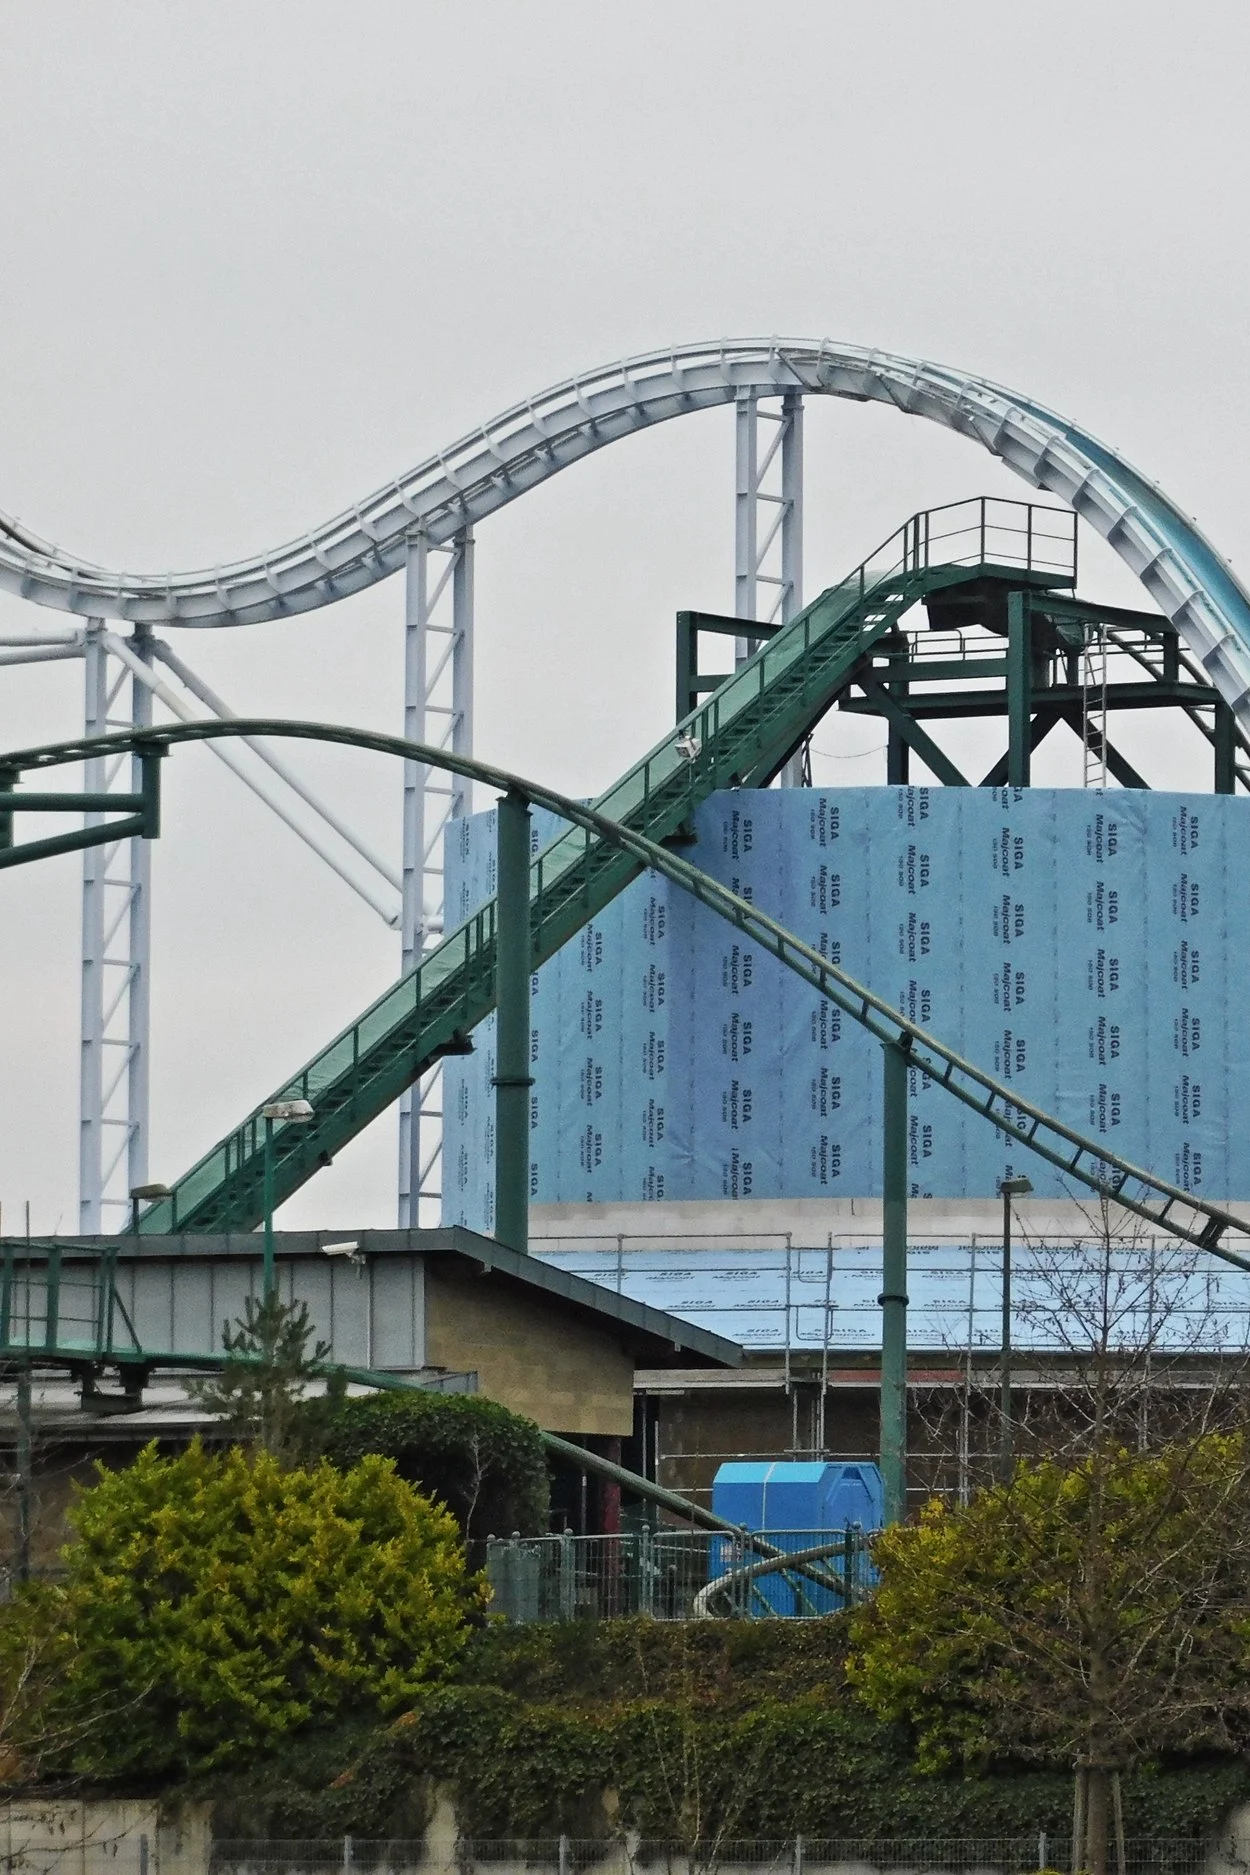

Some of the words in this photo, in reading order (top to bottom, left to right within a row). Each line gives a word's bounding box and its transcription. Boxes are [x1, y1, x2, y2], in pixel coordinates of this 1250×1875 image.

[920, 788, 929, 820] SIGA
[730, 811, 739, 860] Majcoat
[743, 820, 752, 852] SIGA
[817, 798, 826, 847] Majcoat
[831, 807, 839, 840] SIGA
[1095, 814, 1103, 863] Majcoat
[1179, 806, 1187, 855] Majcoat
[531, 830, 539, 857] SIG
[1001, 828, 1010, 876] Majcoat
[1014, 837, 1023, 869] SIGA
[1108, 824, 1117, 856] SIGA
[907, 845, 916, 894] Majcoat
[920, 855, 929, 887] SIGA
[818, 865, 827, 914] Majcoat
[831, 874, 840, 907] SIGA
[1095, 881, 1104, 930] Majcoat
[1179, 873, 1187, 922] Majcoat
[1191, 884, 1199, 916] SIGA
[1001, 895, 1010, 944] Majcoat
[1015, 904, 1024, 937] SIGA
[1109, 891, 1118, 923] SIGA
[831, 941, 840, 965] SIG
[907, 913, 916, 962] Majcoat
[921, 923, 930, 954] SIGA
[730, 945, 739, 994] Majcoat
[743, 955, 752, 986] SIGA
[1096, 949, 1105, 997] Majcoat
[1109, 959, 1118, 991] SIGA
[1180, 941, 1188, 989] Majcoat
[1191, 951, 1199, 983] SIGA
[1001, 963, 1011, 1011] Majcoat
[1016, 972, 1024, 1005] SIGA
[921, 990, 930, 1022] SIGA
[730, 1013, 739, 1061] Majcoat
[743, 1022, 751, 1055] SIGA
[819, 1000, 828, 1049] Majcoat
[832, 1009, 840, 1042] SIGA
[1097, 1016, 1106, 1065] Majcoat
[1181, 1008, 1189, 1057] Majcoat
[1192, 1018, 1200, 1050] SIGA
[1003, 1030, 1012, 1079] Majcoat
[1016, 1040, 1025, 1072] SIGA
[1111, 1026, 1120, 1058] SIGA
[730, 1080, 739, 1129] Majcoat
[743, 1090, 751, 1123] SIGA
[819, 1068, 828, 1116] Majcoat
[832, 1077, 840, 1109] SIGA
[1098, 1084, 1107, 1133] Majcoat
[1192, 1085, 1200, 1117] SIGA
[1016, 1107, 1026, 1130] SIG
[1111, 1094, 1120, 1126] SIGA
[909, 1116, 918, 1165] Majcoat
[923, 1125, 932, 1157] SIGA
[819, 1136, 828, 1184] Majcoat
[832, 1145, 841, 1177] SIGA
[1193, 1153, 1201, 1185] SIGA
[743, 1163, 752, 1195] SIGA
